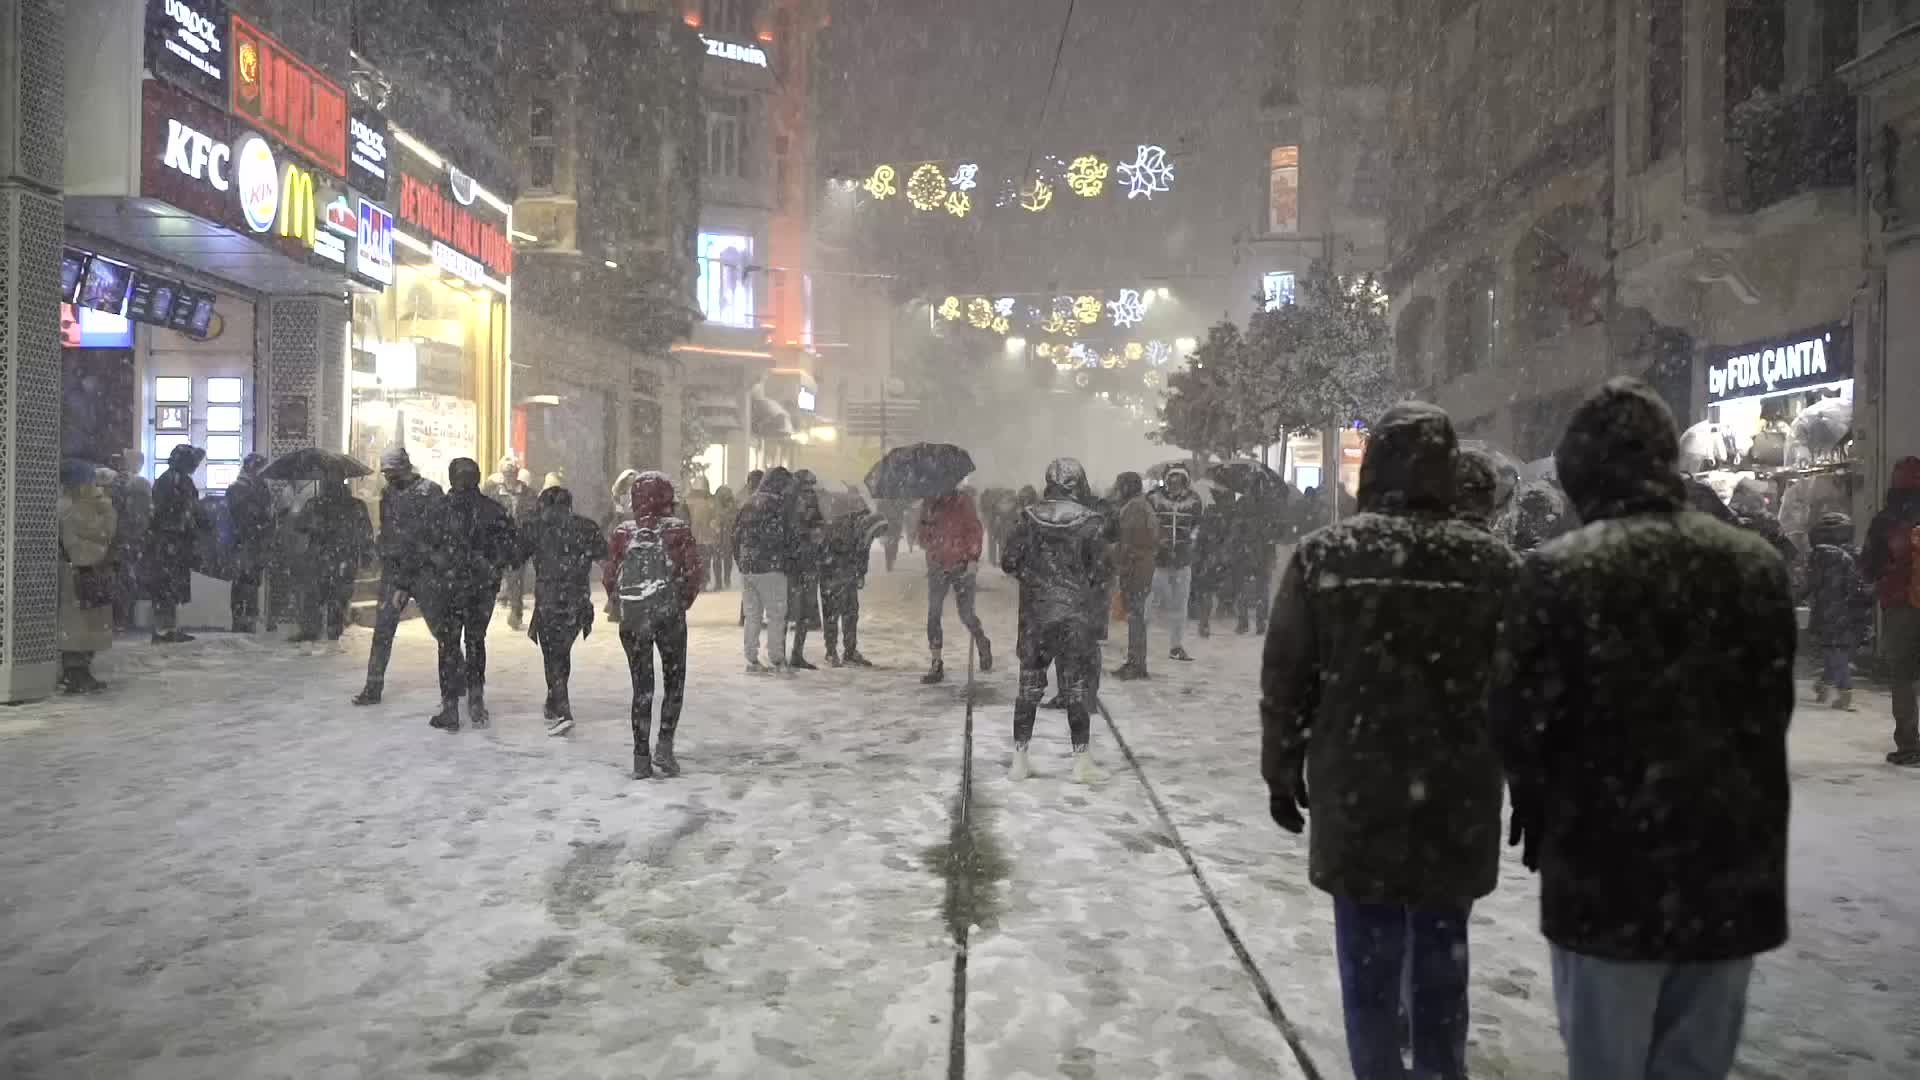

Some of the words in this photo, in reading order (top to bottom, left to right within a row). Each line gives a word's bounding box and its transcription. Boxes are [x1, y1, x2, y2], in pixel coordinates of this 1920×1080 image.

[164, 118, 230, 192] KFC
[1709, 365, 1727, 397] by
[1727, 352, 1761, 390] FOX
[1762, 338, 1827, 391] ÇANTA
